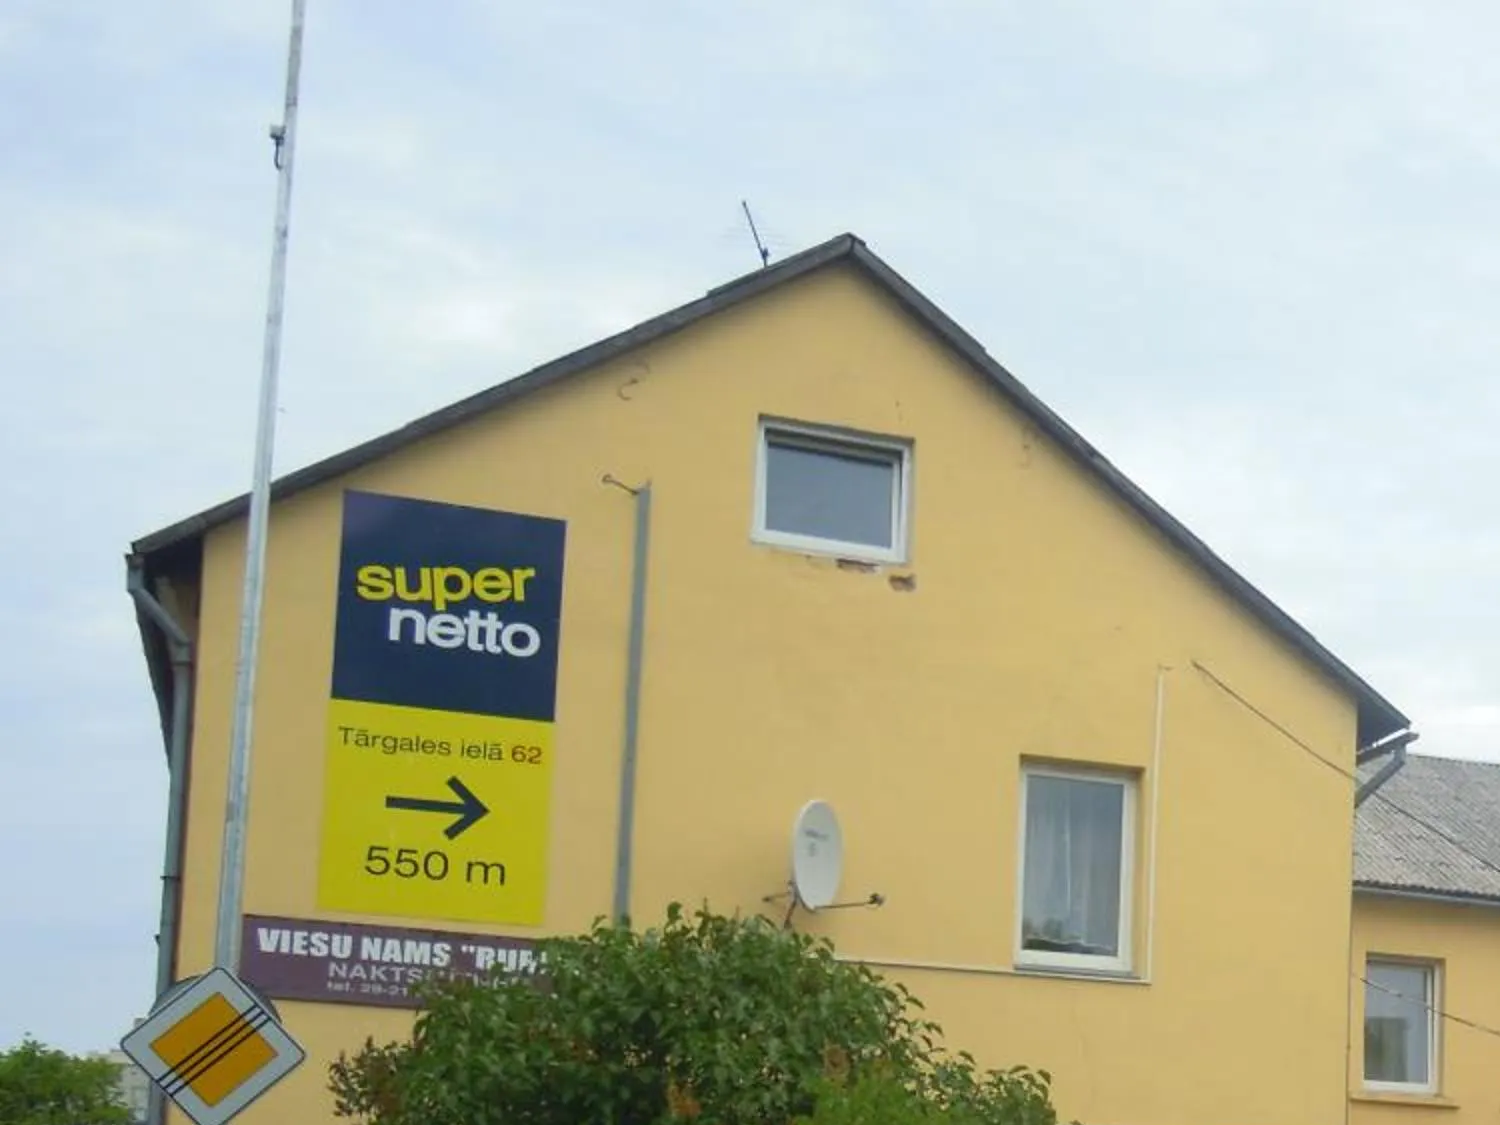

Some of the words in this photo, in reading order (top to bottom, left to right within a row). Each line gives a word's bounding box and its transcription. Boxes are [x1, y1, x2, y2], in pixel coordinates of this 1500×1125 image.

[356, 565, 536, 611] super
[388, 607, 541, 657] netto
[338, 725, 451, 756] Tārgales
[460, 738, 503, 762] ielā
[511, 745, 543, 765] 62
[364, 845, 449, 881] 550
[465, 860, 506, 886] m
[257, 927, 353, 959] VIESU
[361, 936, 451, 967] NAMS
